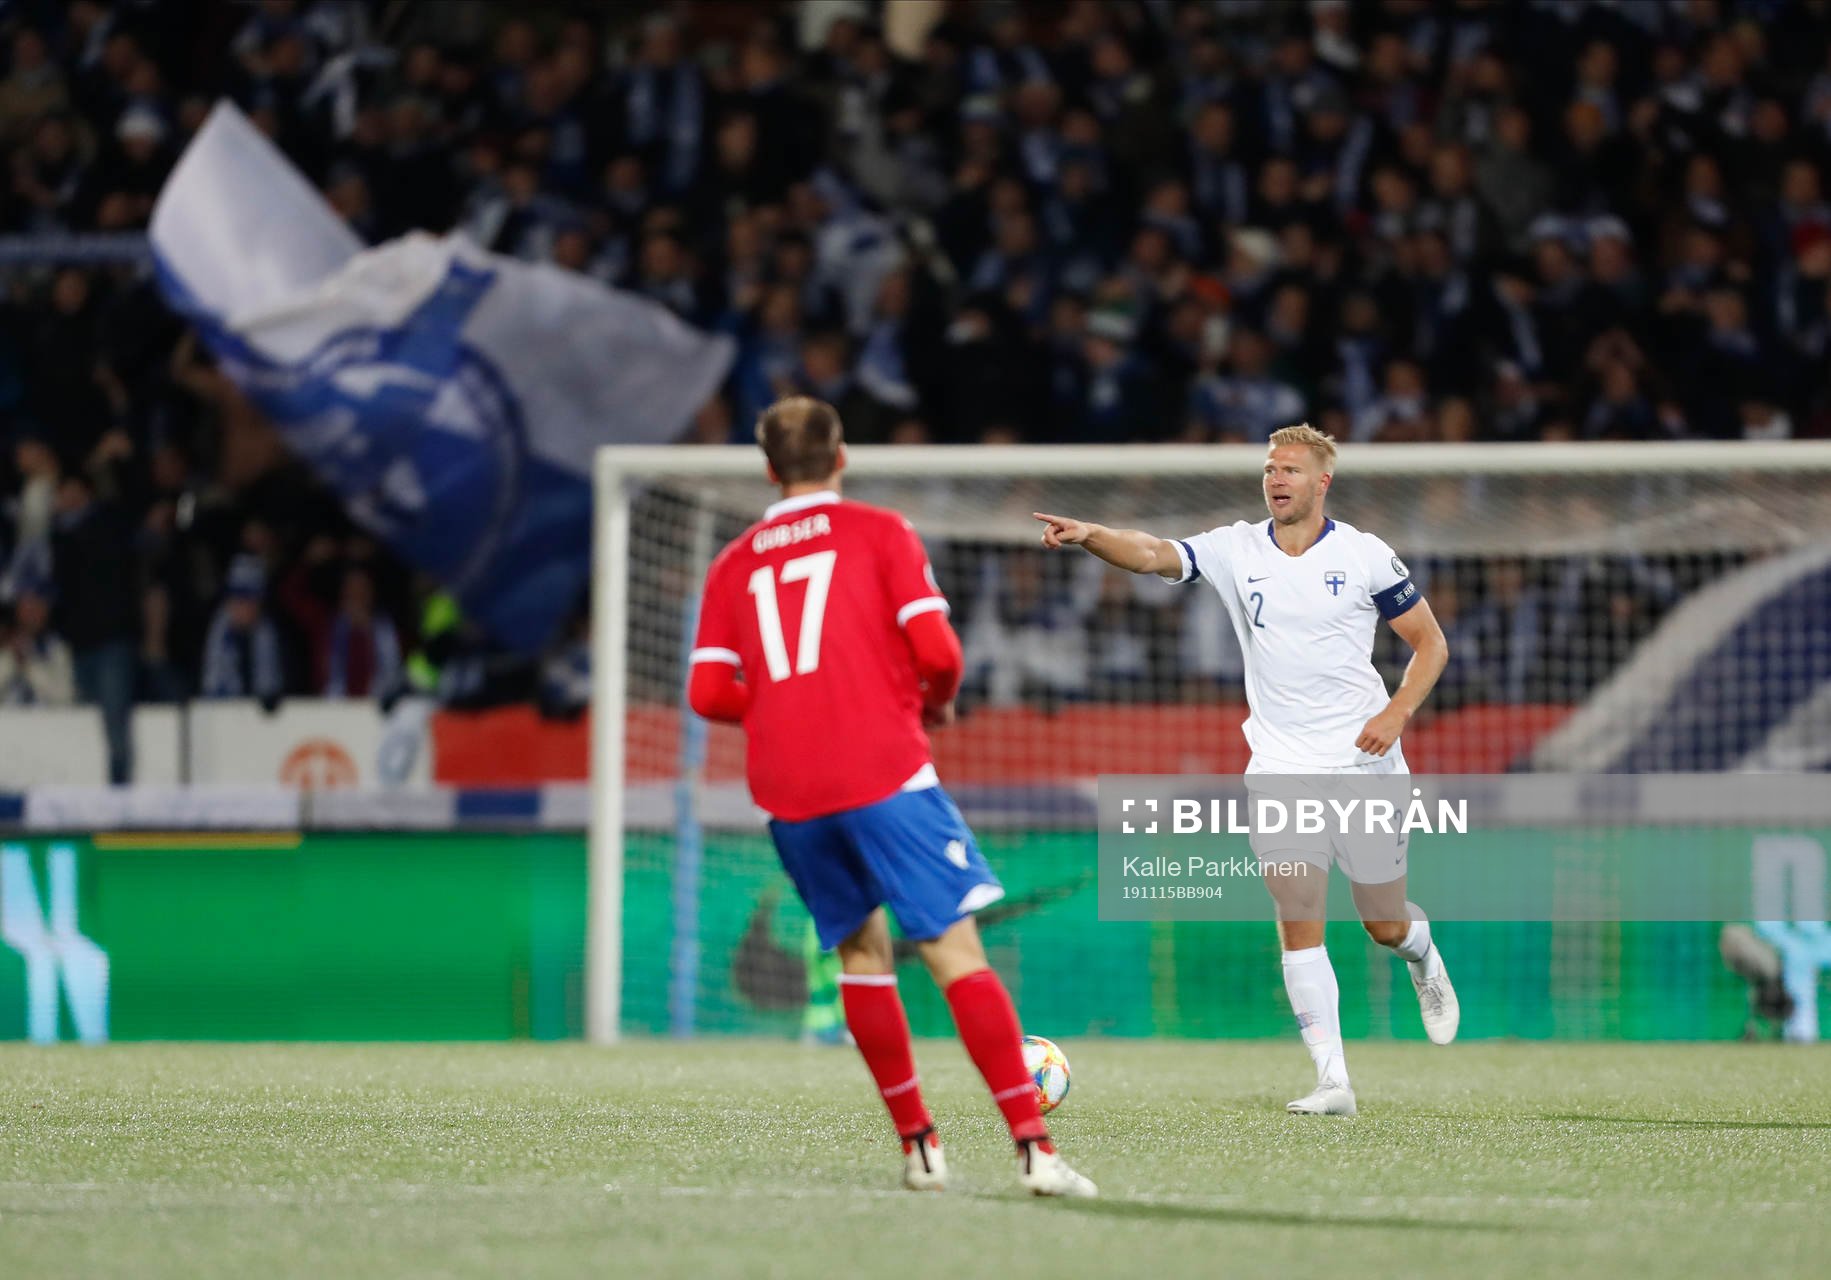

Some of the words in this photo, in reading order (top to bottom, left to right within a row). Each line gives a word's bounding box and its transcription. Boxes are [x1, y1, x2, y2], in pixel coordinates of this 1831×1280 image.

[748, 550, 837, 682] 17
[1250, 591, 1265, 628] 2
[1394, 808, 1405, 847] 2
